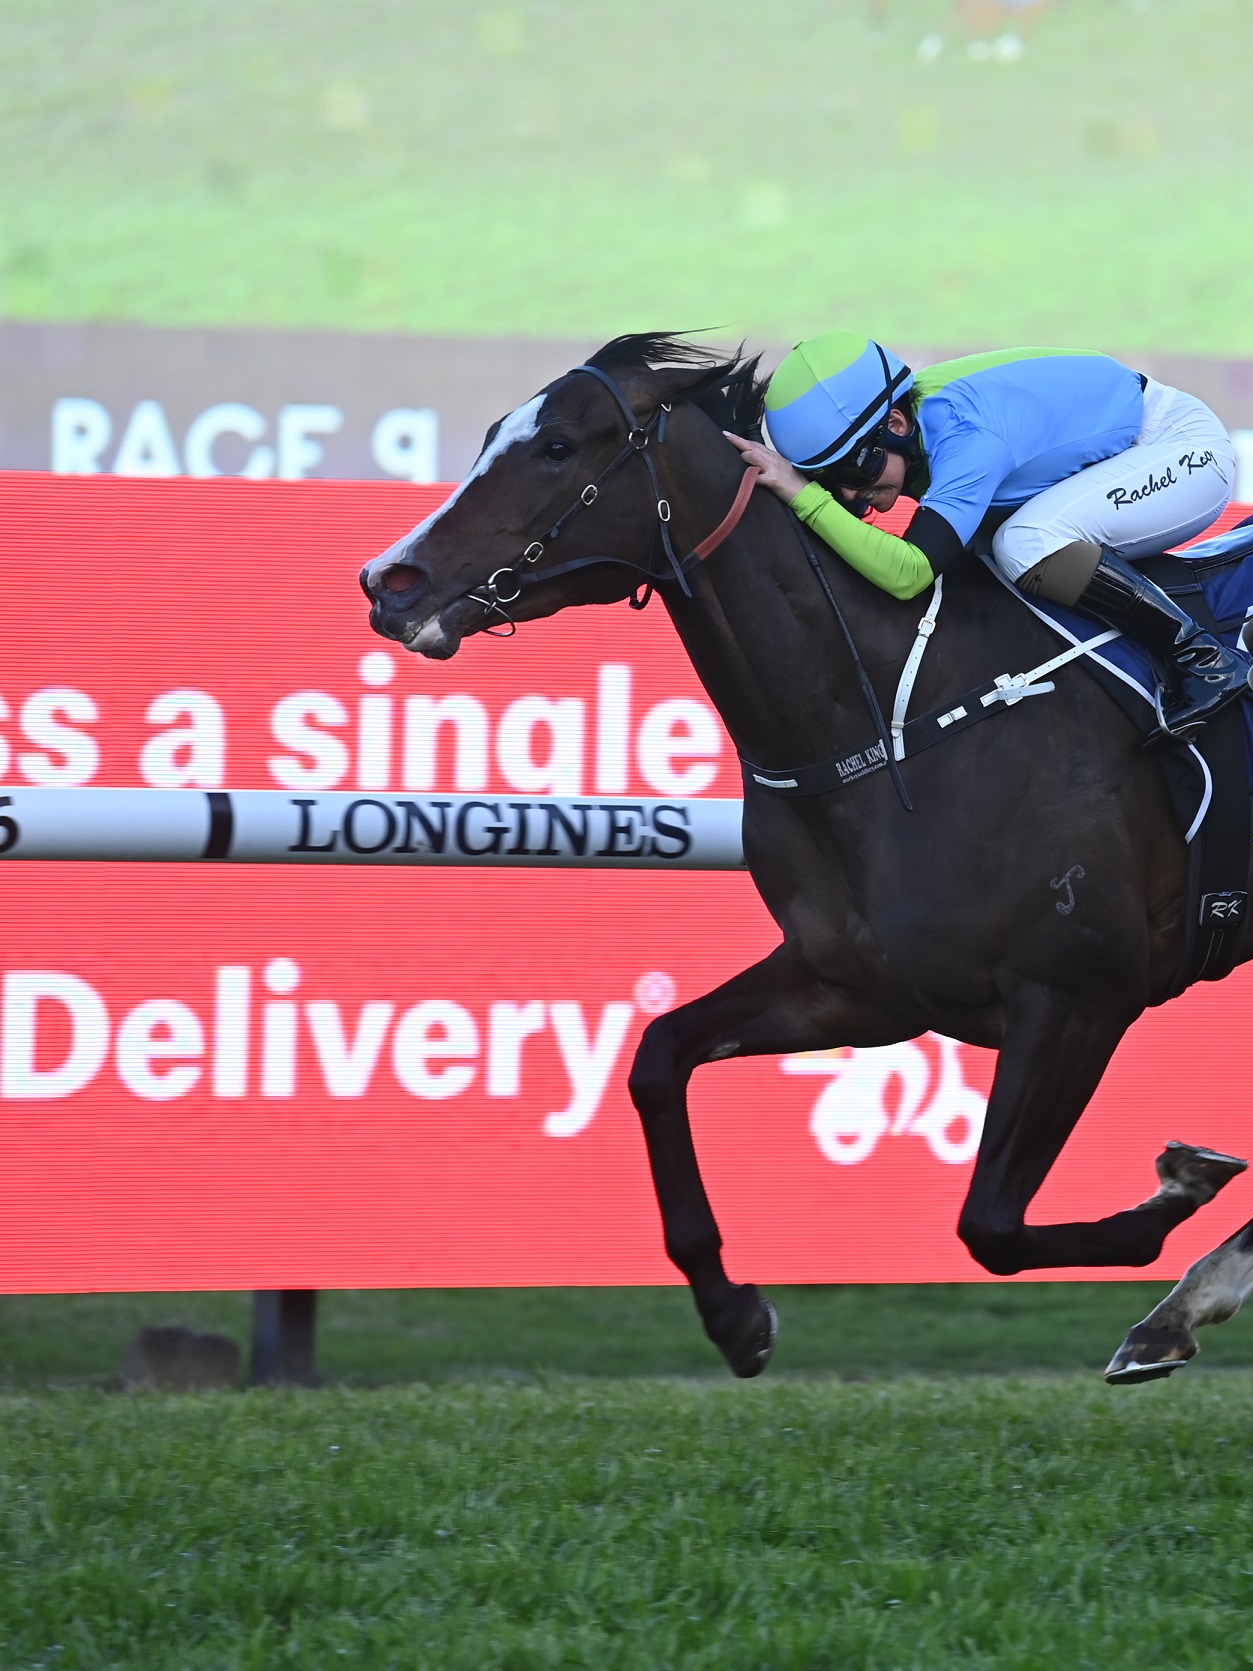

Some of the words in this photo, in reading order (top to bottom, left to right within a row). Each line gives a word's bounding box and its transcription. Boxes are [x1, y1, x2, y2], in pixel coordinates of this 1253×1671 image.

[1106, 466, 1177, 510] Rachel
[0, 687, 100, 787] s
[139, 690, 225, 788] a
[267, 652, 723, 797] single
[836, 754, 866, 777] RACHEL
[288, 799, 692, 859] LONGINES
[1210, 899, 1243, 918] RK
[0, 957, 634, 1138] Delivery
